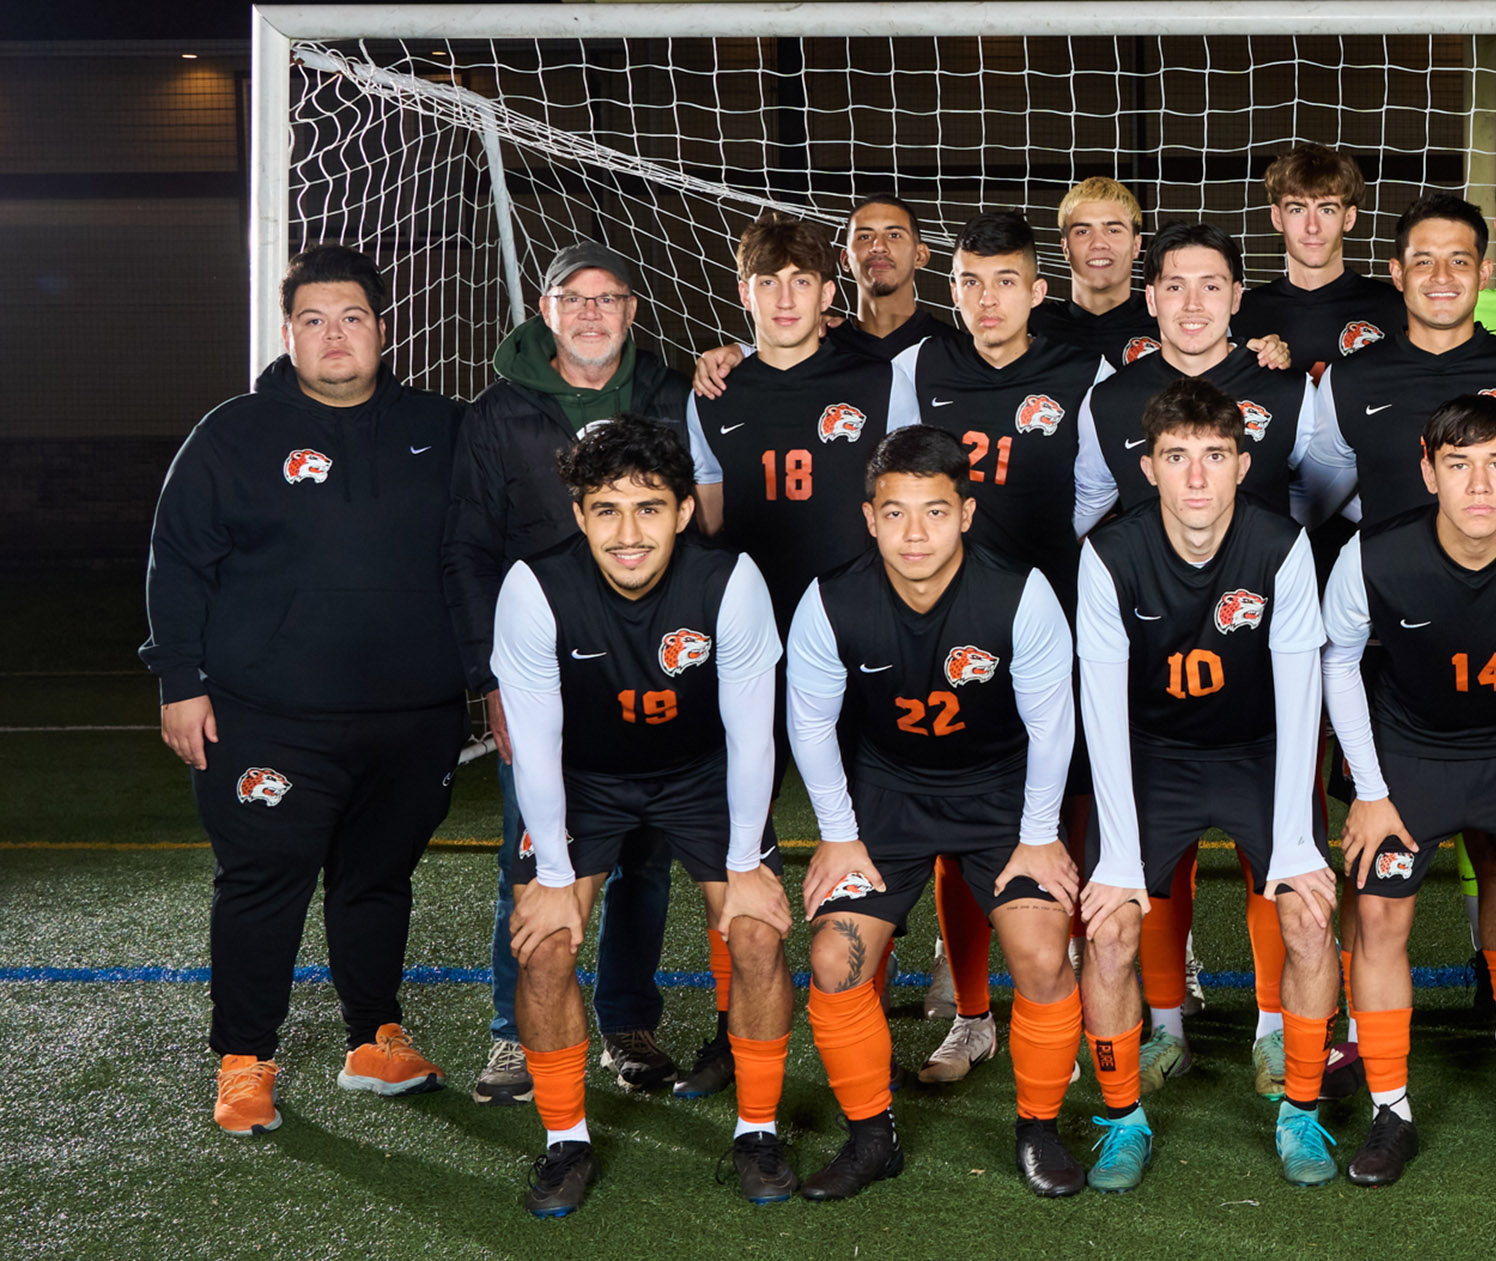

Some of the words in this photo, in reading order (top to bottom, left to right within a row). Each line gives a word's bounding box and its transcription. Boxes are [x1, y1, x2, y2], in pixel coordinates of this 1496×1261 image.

[762, 449, 812, 500] 18
[962, 430, 1013, 485] 21
[1166, 649, 1224, 699] 10
[618, 689, 677, 724] 19
[895, 691, 966, 736] 22
